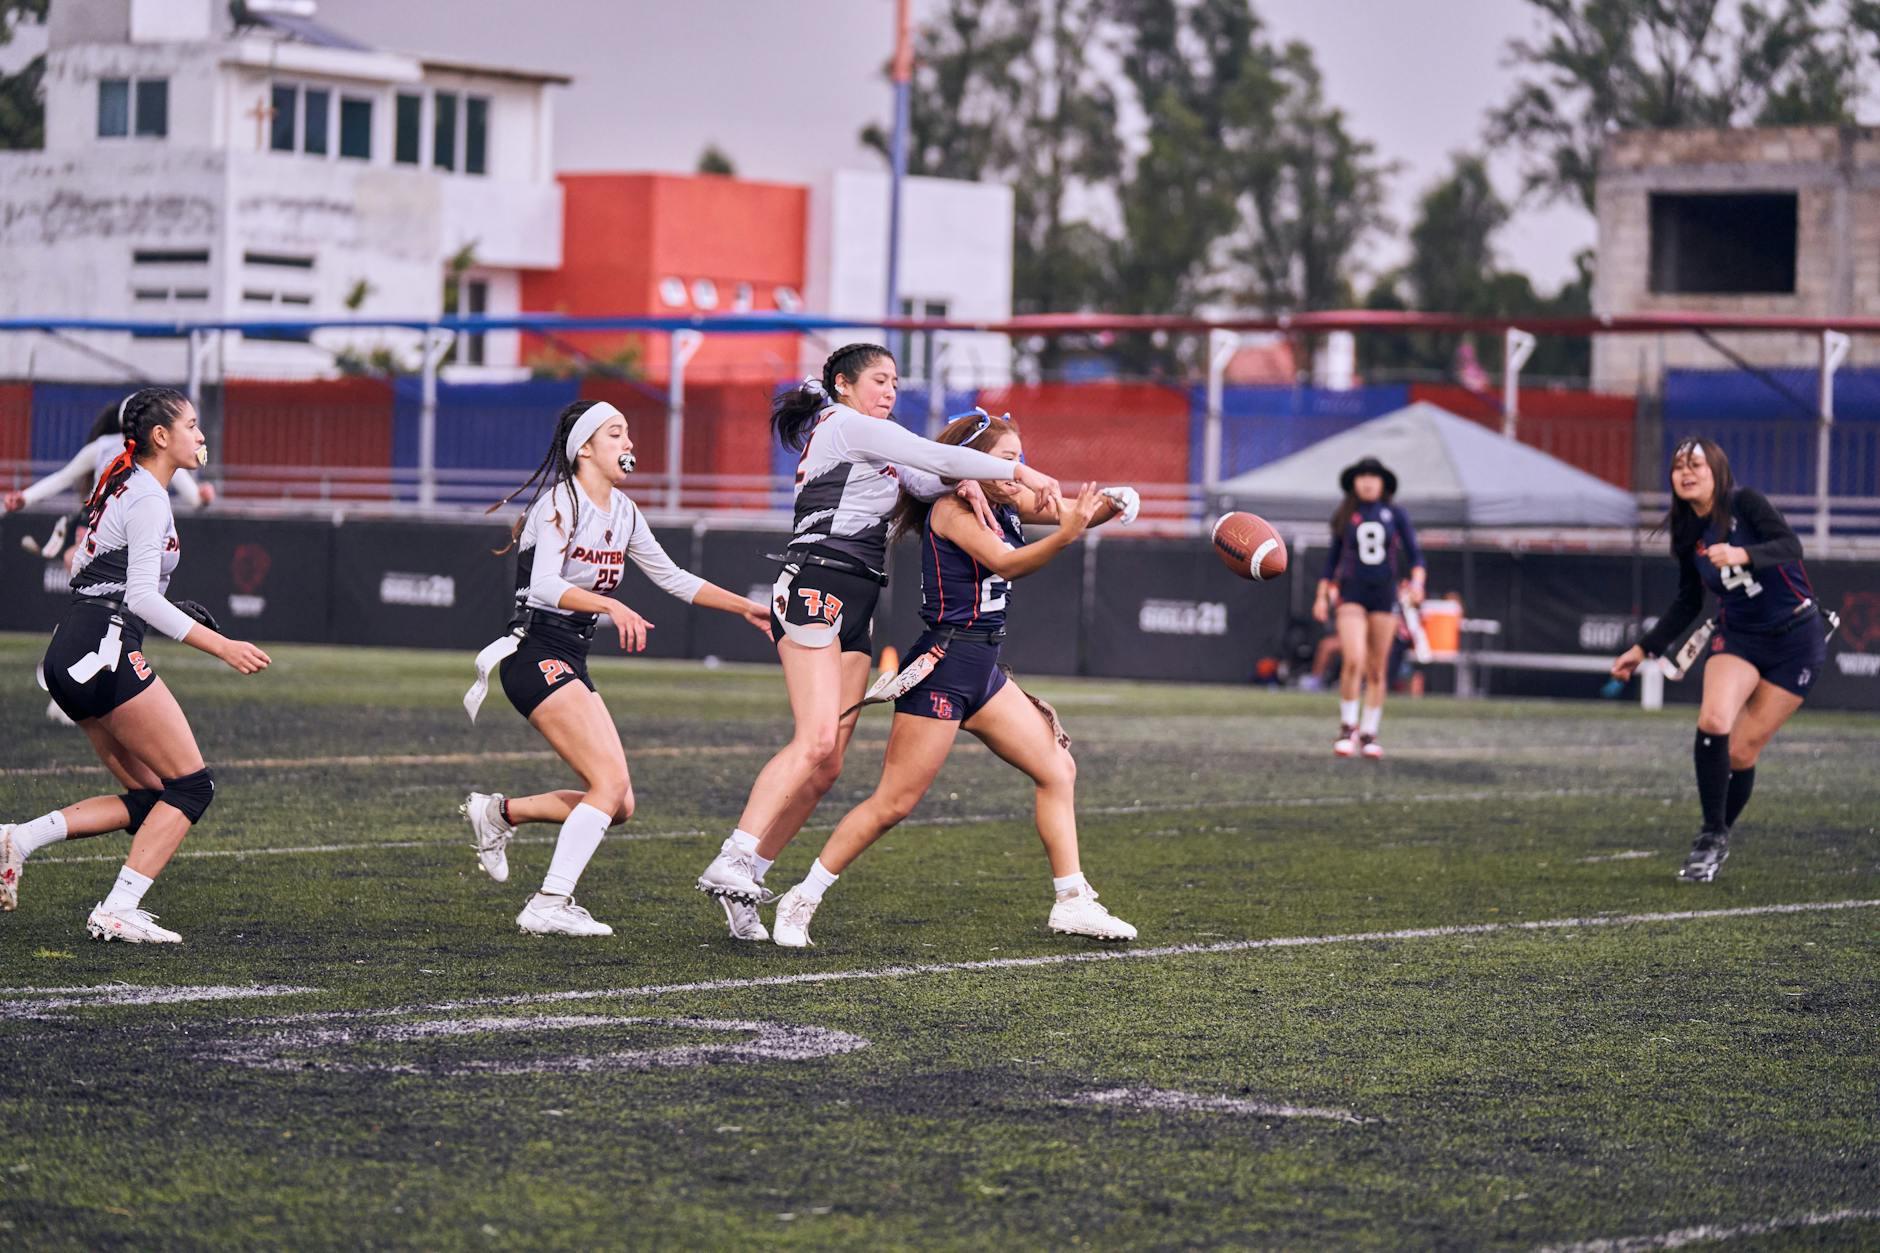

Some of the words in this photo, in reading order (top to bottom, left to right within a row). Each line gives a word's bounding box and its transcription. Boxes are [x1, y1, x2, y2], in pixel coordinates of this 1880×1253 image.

[1356, 521, 1386, 565] 8
[571, 546, 625, 565] PANTER
[591, 568, 620, 592] 25
